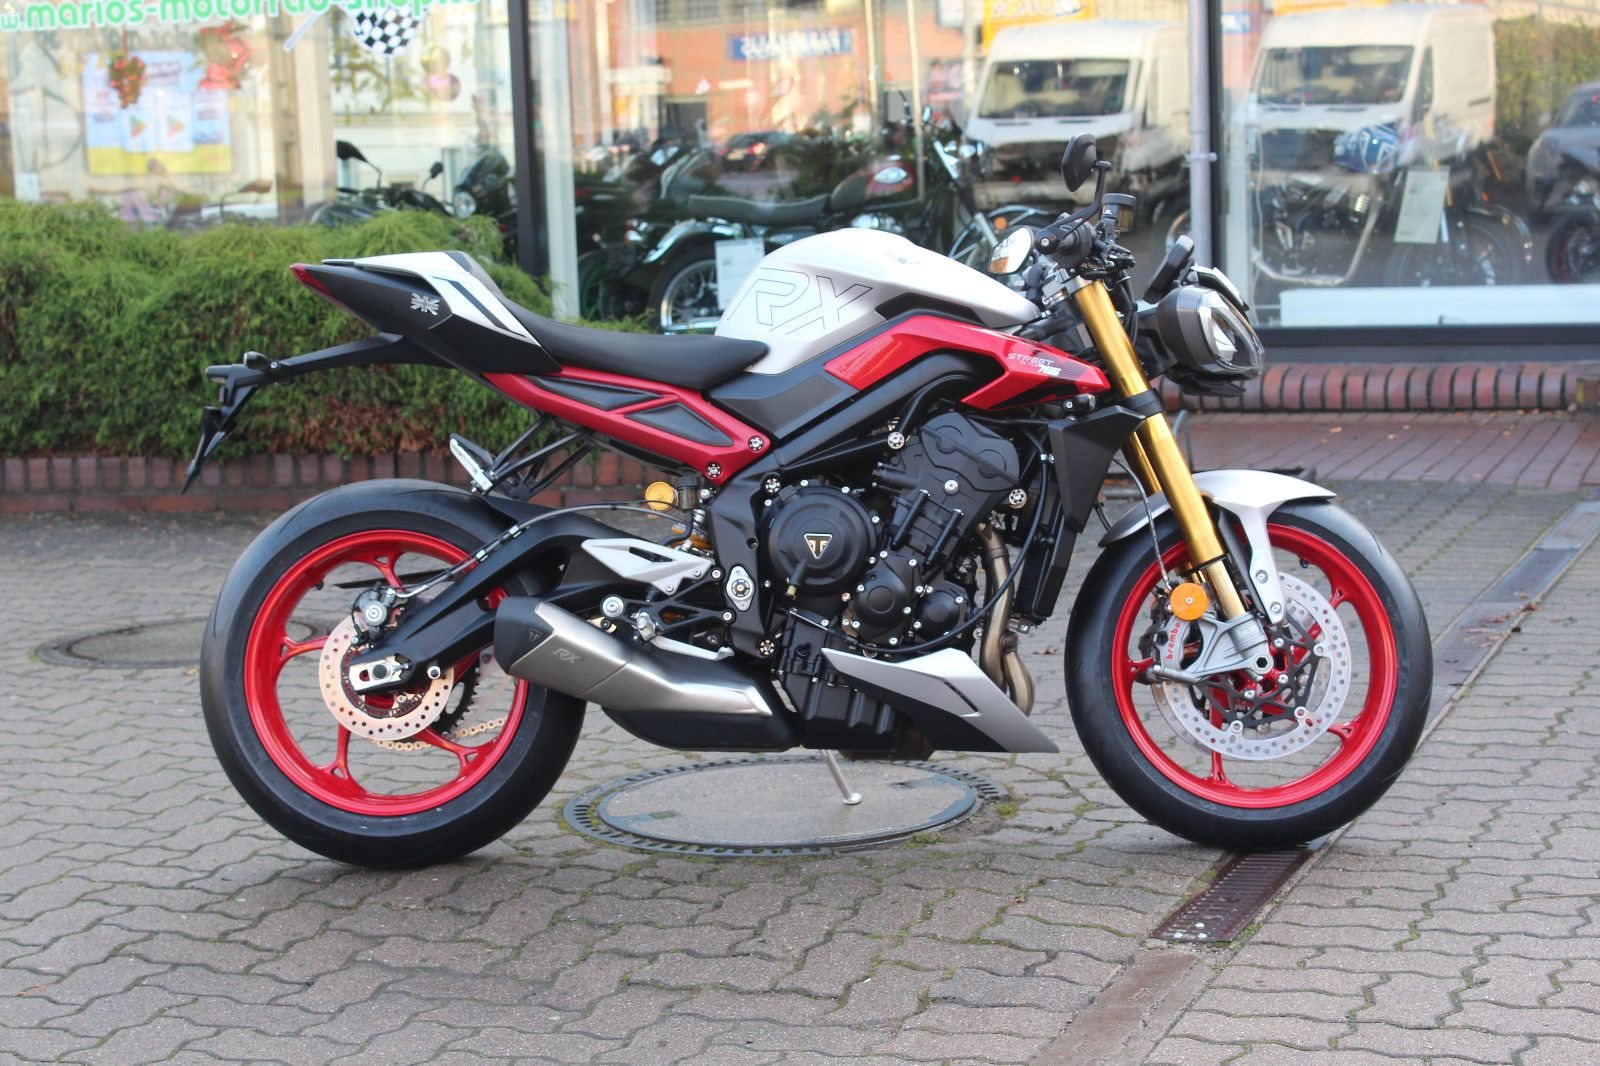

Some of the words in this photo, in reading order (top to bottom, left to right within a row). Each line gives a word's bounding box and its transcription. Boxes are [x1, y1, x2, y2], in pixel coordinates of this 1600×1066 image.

[0, 0, 481, 30] w.marios-motorra-p.
[726, 267, 873, 336] RX
[1007, 352, 1054, 367] STREET
[553, 647, 582, 664] RX
[1165, 622, 1182, 660] brembo
